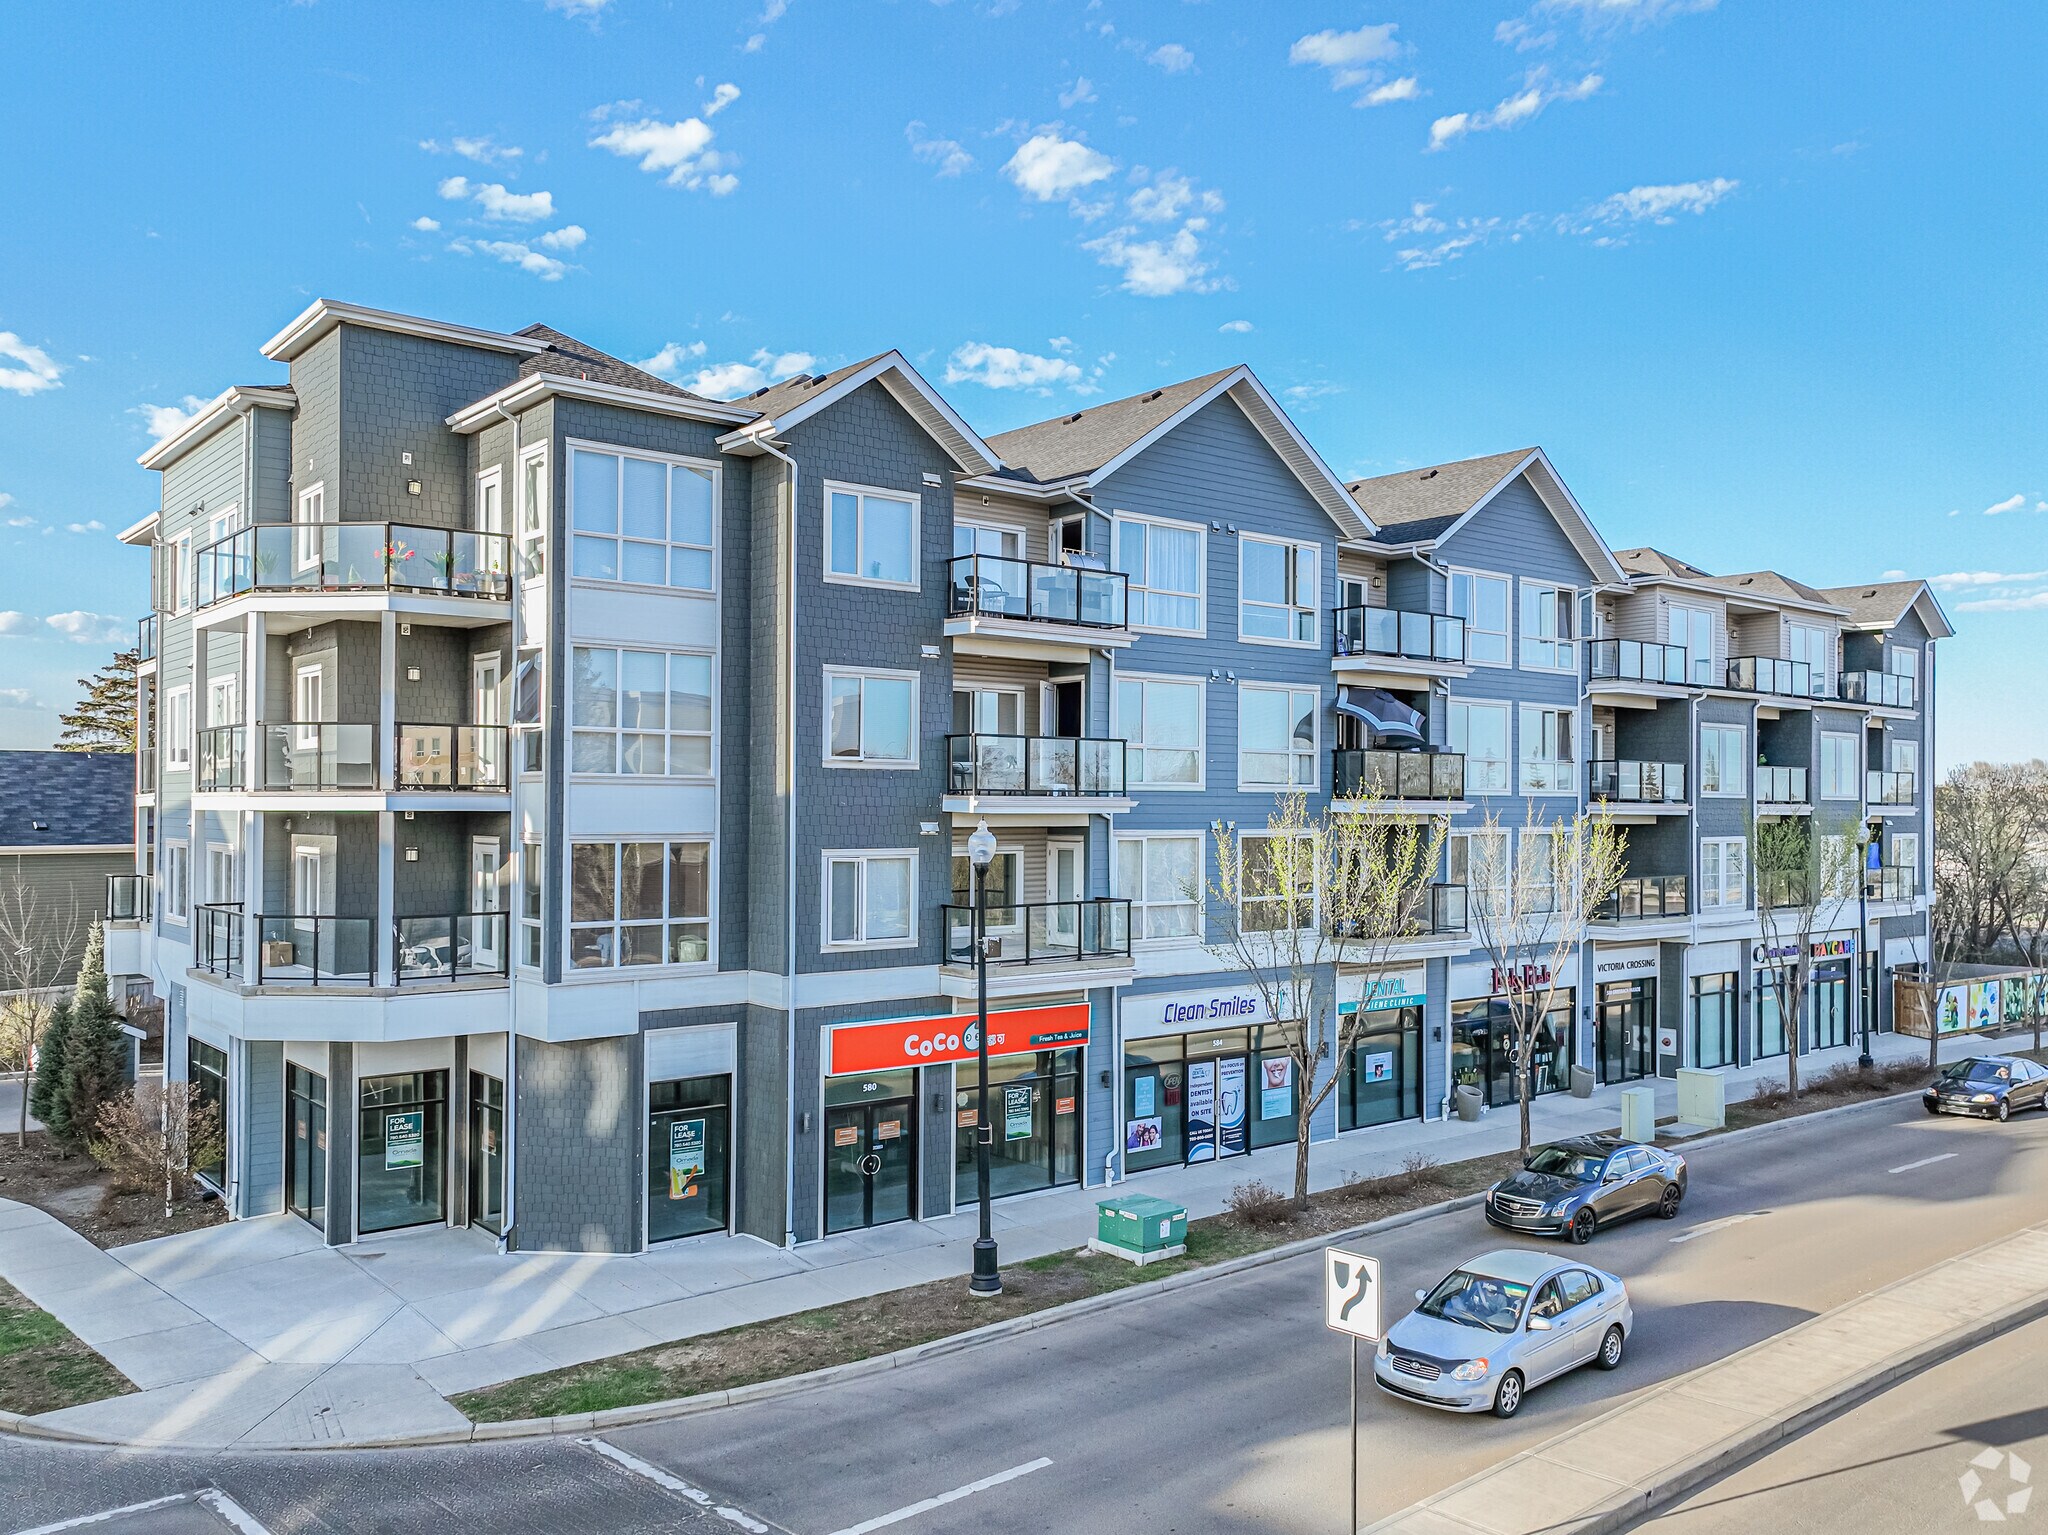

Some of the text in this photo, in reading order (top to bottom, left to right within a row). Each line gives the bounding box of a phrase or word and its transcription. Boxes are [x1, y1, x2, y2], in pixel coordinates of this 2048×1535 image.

[1813, 939, 1855, 957] DAYCARE
[1597, 958, 1656, 972] VICTORIA CROSSING
[1363, 978, 1407, 997] DENTAL
[1389, 997, 1414, 1007] CLINIC
[1164, 995, 1256, 1023] Clean Smiles
[1039, 1034, 1053, 1042] Fresh
[1054, 1033, 1063, 1041] Tea
[1069, 1031, 1082, 1039] Juice
[904, 1033, 960, 1057] CoCo
[862, 1082, 877, 1092] 580
[1008, 1092, 1019, 1100] FOR
[1190, 1089, 1213, 1097] DENTIST
[1190, 1099, 1213, 1107] available
[1200, 1107, 1212, 1115] SITE
[390, 1117, 405, 1125] FOR
[390, 1123, 413, 1131] LEASE
[674, 1124, 689, 1132] FOR
[674, 1130, 696, 1139] LEASE
